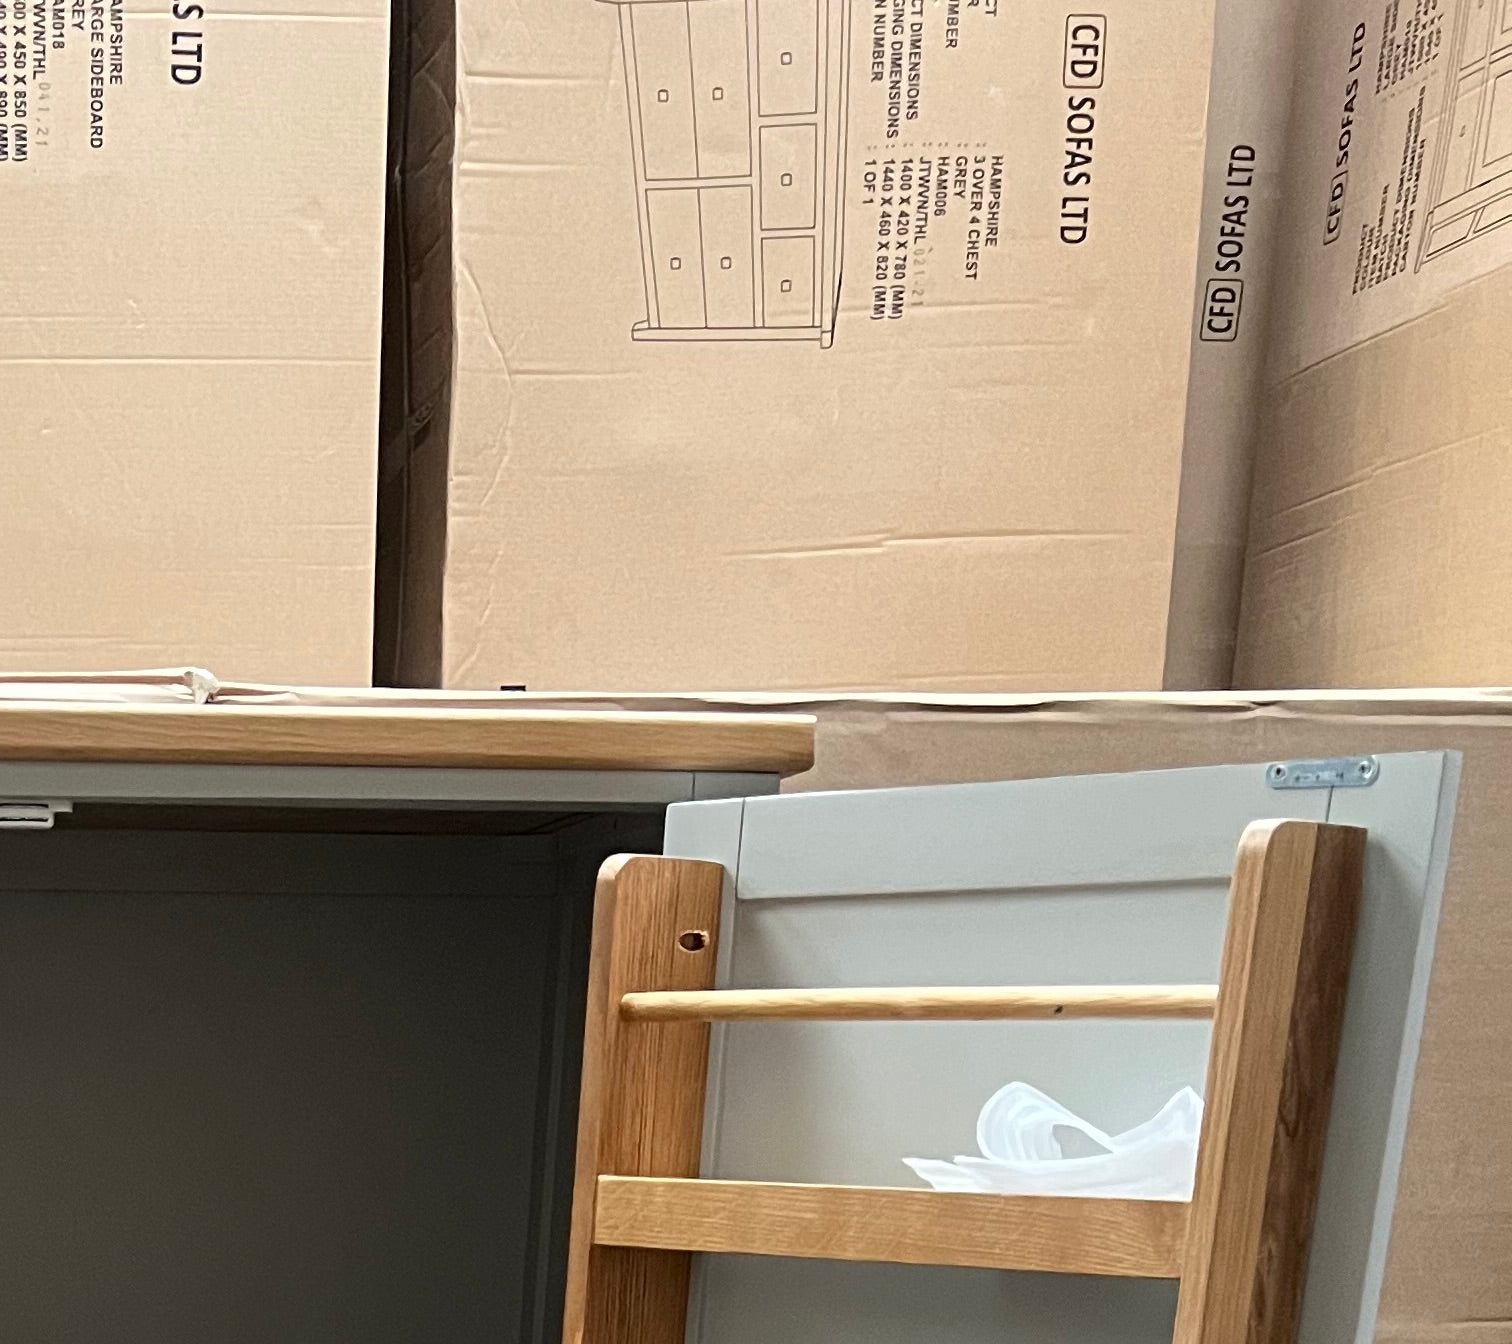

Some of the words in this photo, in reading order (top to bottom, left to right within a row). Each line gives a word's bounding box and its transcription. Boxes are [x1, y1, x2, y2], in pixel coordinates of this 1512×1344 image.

[13, 25, 27, 36] X
[945, 0, 960, 49] MBER
[13, 41, 27, 69] 450
[170, 31, 203, 86] LTD
[871, 14, 886, 83] NUMBER
[1070, 24, 1100, 79] CFD
[1348, 21, 1366, 74] LTD
[13, 74, 27, 85] X
[886, 41, 904, 139] DIMENSIONS
[906, 22, 923, 121] DIMENSIONS
[13, 90, 28, 118] 850
[90, 47, 104, 149] SIDEBOARD
[10, 123, 28, 162] (MM)
[1063, 95, 1096, 187] SOFAS
[1335, 78, 1359, 168] SOFAS
[881, 158, 896, 192] 1440
[899, 158, 914, 192] 1400
[953, 155, 968, 200] GREY
[974, 155, 986, 165] 3
[1226, 144, 1256, 187] LTD
[863, 171, 877, 193] OF
[880, 196, 893, 207] X
[898, 195, 912, 206] X
[934, 156, 950, 217] HAM006
[969, 170, 985, 212] OVER
[985, 155, 1004, 248] HAMPSHIRE
[878, 210, 892, 236] 460
[896, 210, 911, 236] 420
[969, 215, 981, 225] 4
[1059, 197, 1090, 245] LTD
[1327, 181, 1345, 234] CFD
[1373, 183, 1390, 250] NUMBER
[876, 241, 890, 252] X
[895, 240, 908, 250] X
[965, 229, 981, 280] CHEST
[1214, 195, 1250, 273] SOFAS
[1383, 209, 1400, 281] PRODUCT
[875, 255, 889, 281] 820
[893, 254, 908, 280] 780
[1352, 223, 1369, 295] PRODUCT
[1359, 225, 1376, 291] COLOUR
[1368, 251, 1379, 288] ITEM
[869, 285, 887, 320] (MM)
[887, 285, 906, 319] (MM)
[1207, 287, 1237, 334] CFD
